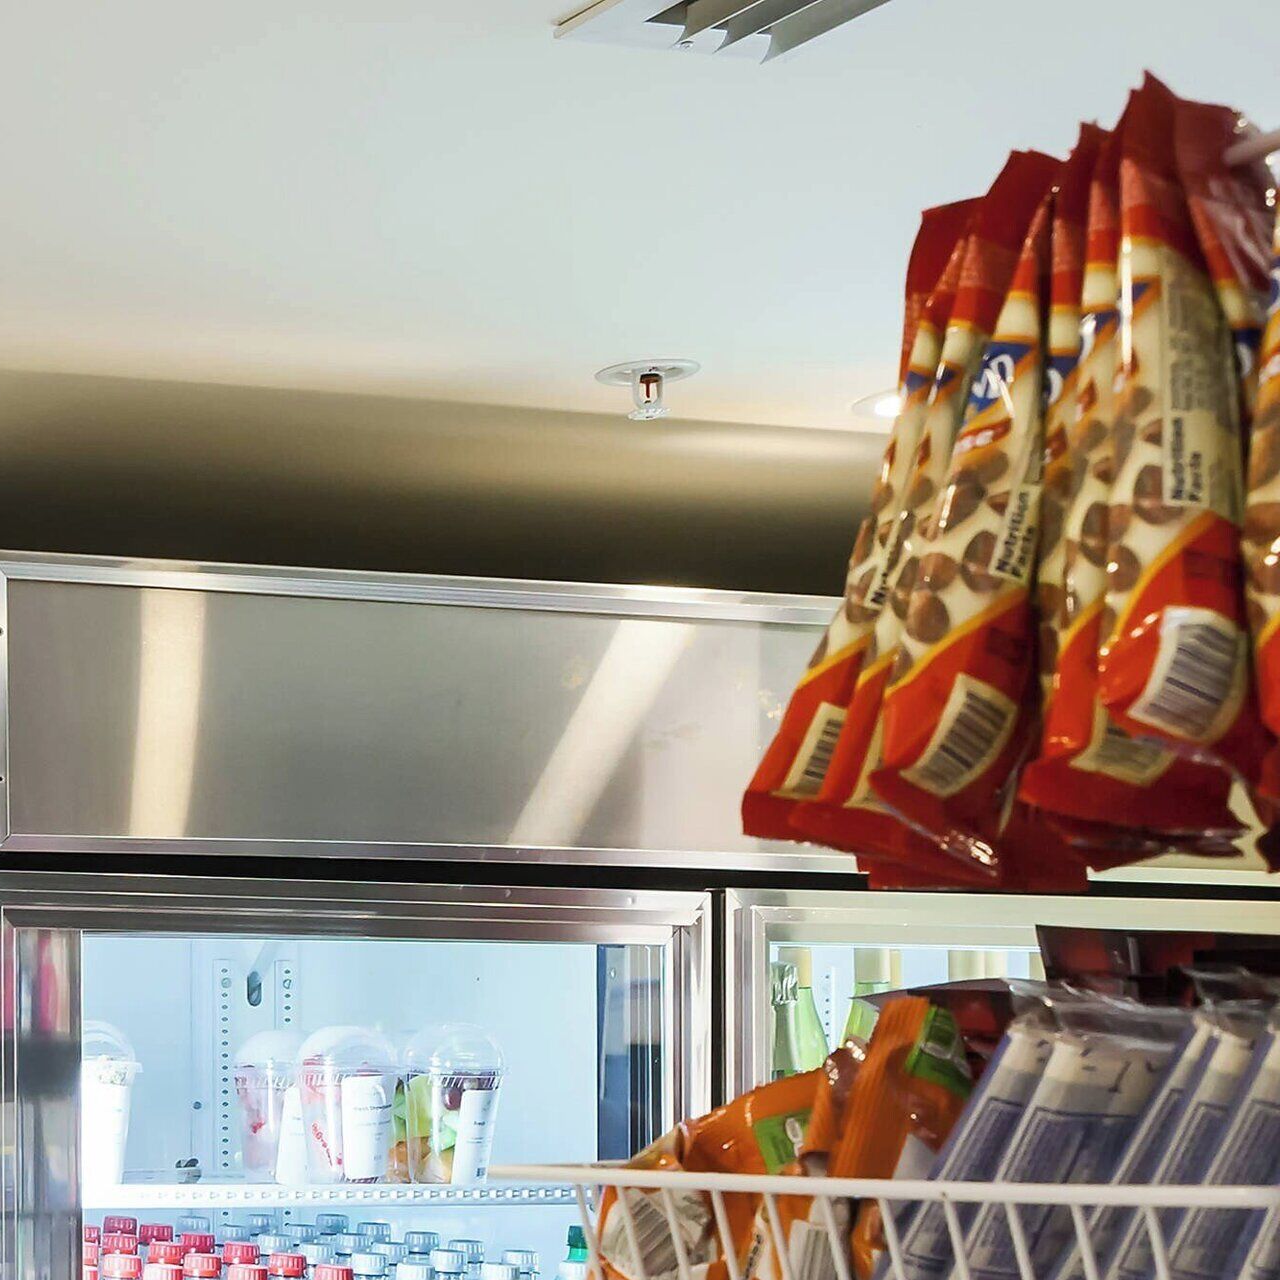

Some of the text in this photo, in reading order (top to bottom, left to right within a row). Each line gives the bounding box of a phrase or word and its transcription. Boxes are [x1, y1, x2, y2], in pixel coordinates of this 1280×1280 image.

[1172, 416, 1183, 499] Nutrition
[1190, 452, 1202, 502] Facts
[996, 491, 1030, 573] Nutrition
[1011, 526, 1035, 578] Facts
